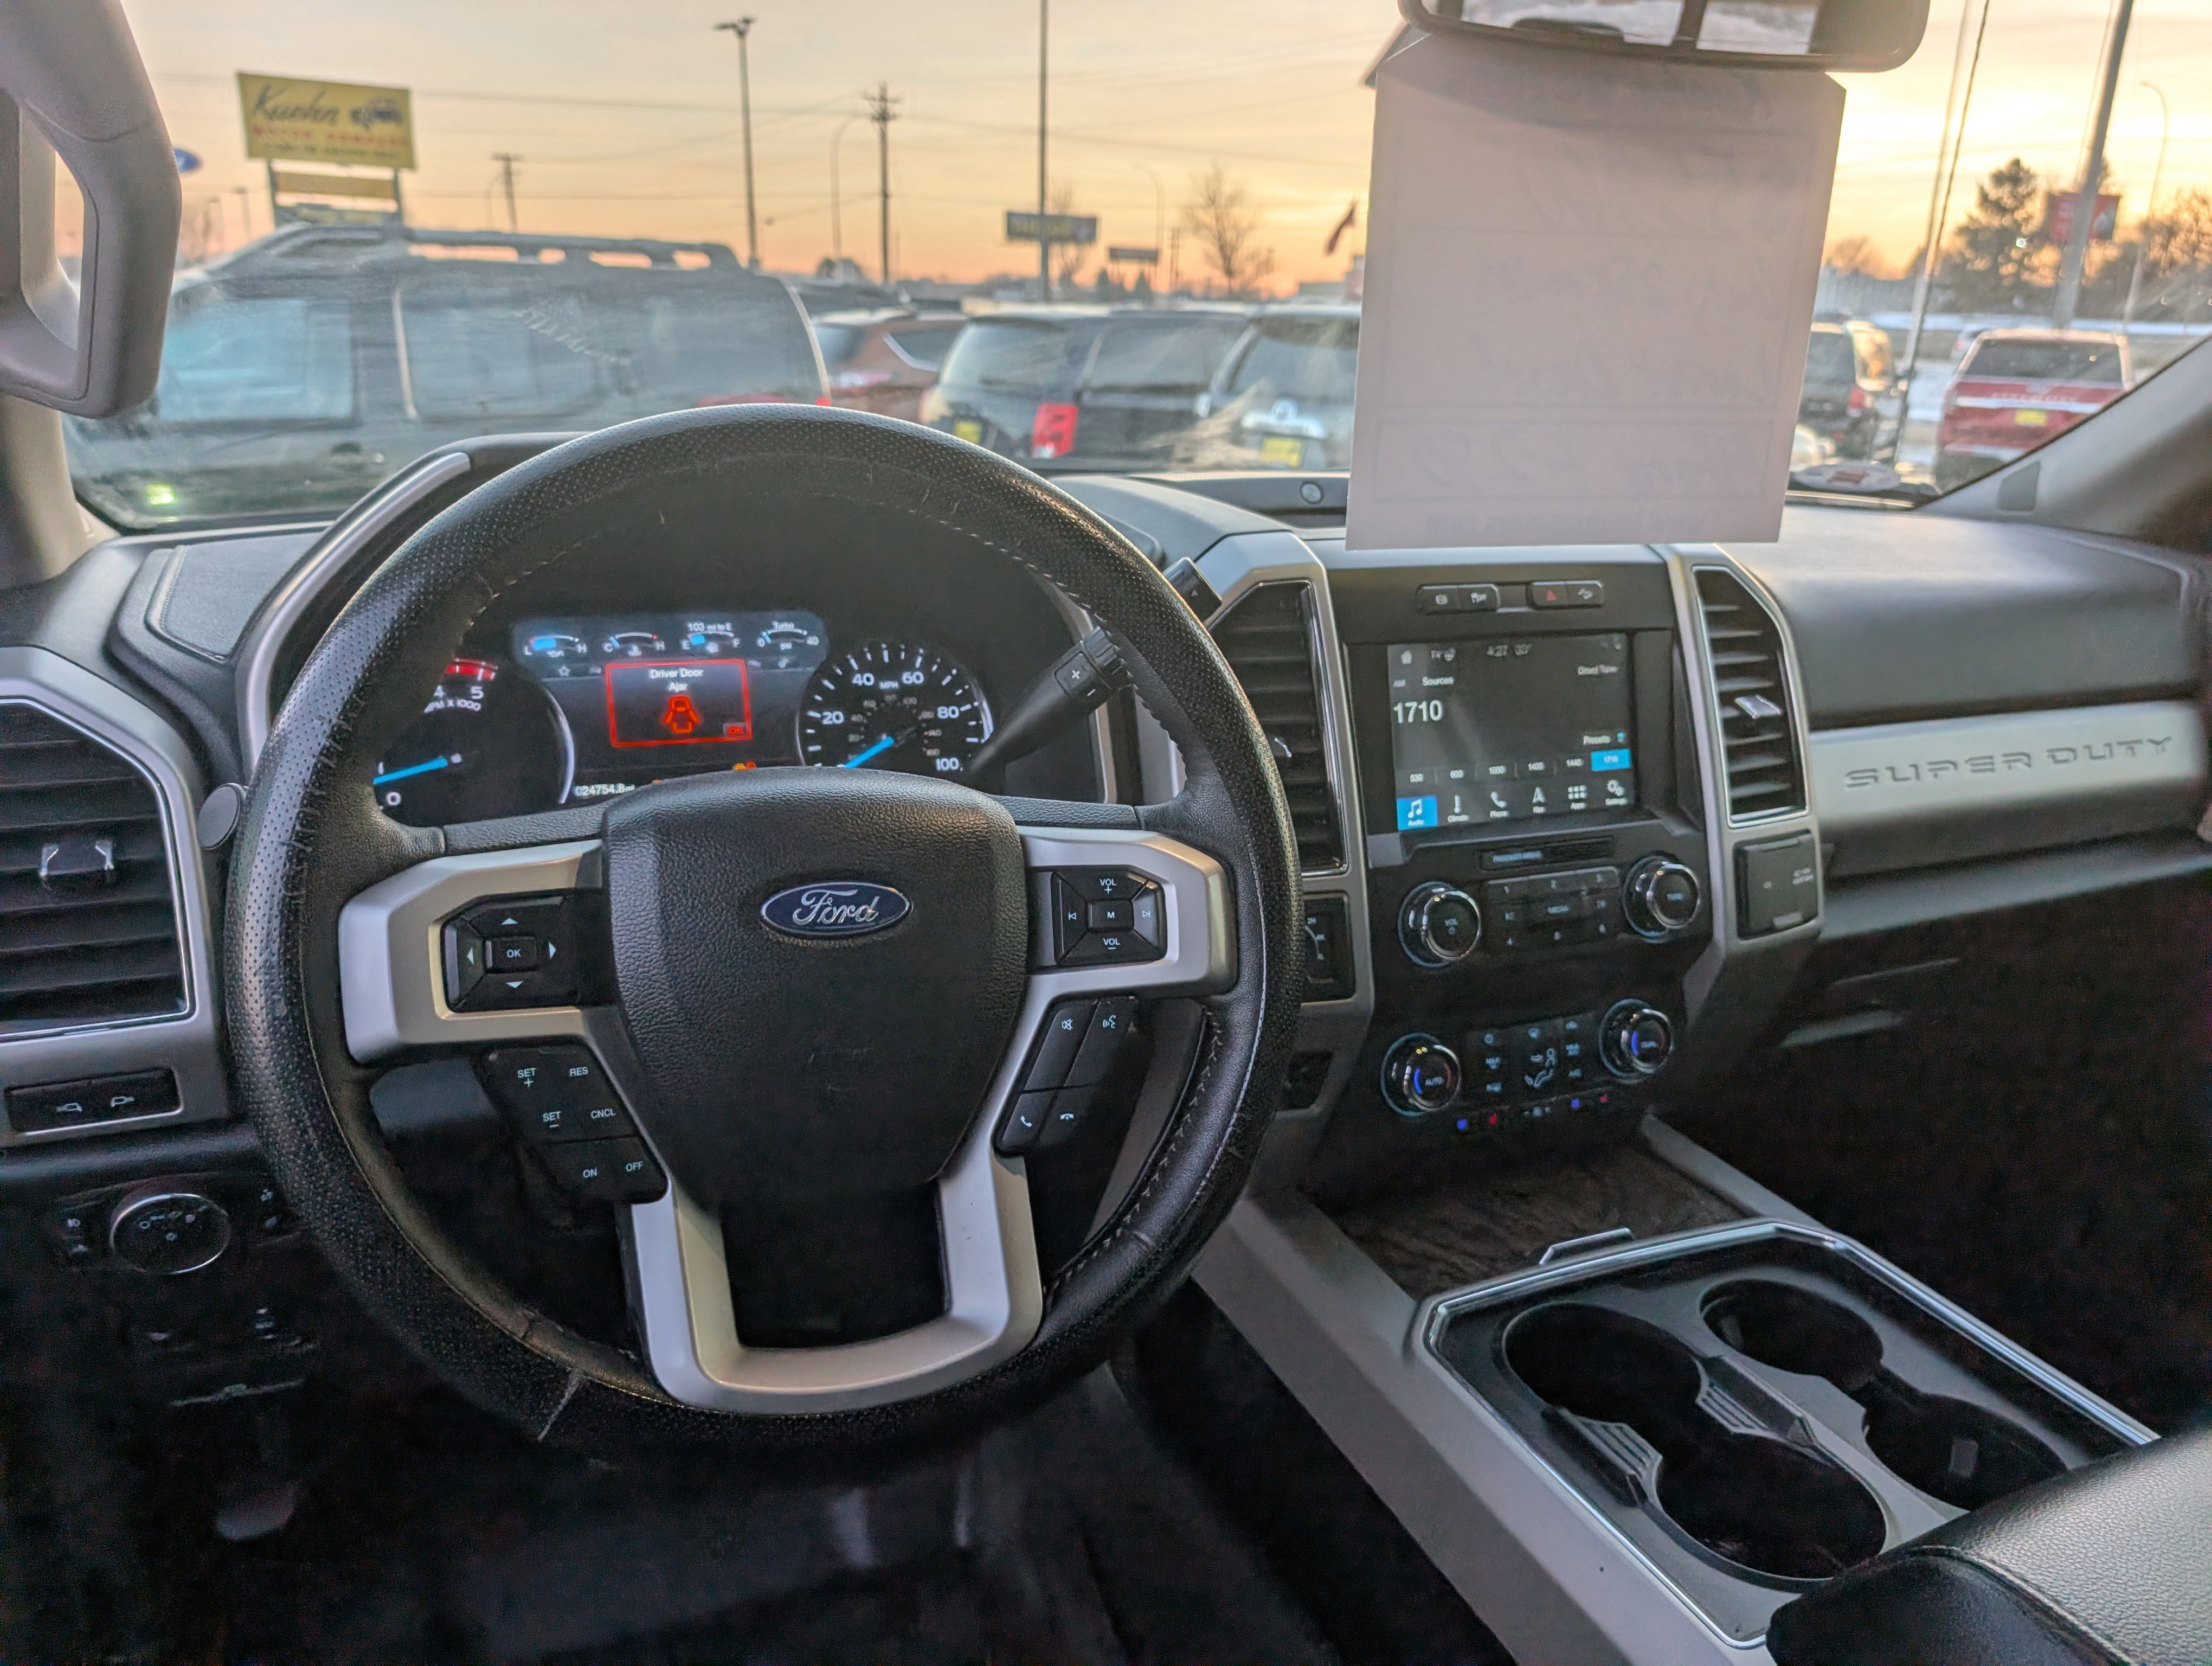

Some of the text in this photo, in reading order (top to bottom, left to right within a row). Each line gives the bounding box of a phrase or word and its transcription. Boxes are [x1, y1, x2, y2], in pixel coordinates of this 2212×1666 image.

[687, 621, 705, 631] 103
[772, 621, 795, 630] Turbo
[523, 645, 533, 656] L
[576, 643, 587, 653] H
[604, 642, 613, 652] C
[654, 640, 665, 651] H
[681, 640, 690, 650] E
[650, 668, 703, 678] Driver Door
[902, 671, 924, 685] 60
[852, 672, 874, 686] 40
[1422, 676, 1454, 687] Sources
[667, 682, 687, 693] Ajar
[878, 680, 899, 690] MPH
[434, 684, 447, 699] 4
[470, 685, 485, 700] 5
[456, 698, 481, 712] 1000
[822, 710, 844, 725] 20
[937, 706, 960, 720] 80
[1393, 700, 1444, 724] 1710
[727, 725, 744, 735] OK
[936, 757, 960, 771] 100
[1846, 736, 2172, 788] SUPER DUTY
[385, 791, 401, 806] 0
[1099, 878, 1117, 887] VOL
[792, 888, 880, 925] Ford
[1107, 911, 1115, 919] M
[1102, 938, 1121, 946] VOL
[507, 949, 522, 958] OK
[517, 1067, 537, 1079] SET
[569, 1066, 589, 1077] RES
[543, 1111, 562, 1122] SET
[590, 1108, 616, 1119] CNCL
[626, 1161, 644, 1172] OFF
[583, 1168, 597, 1178] ON
